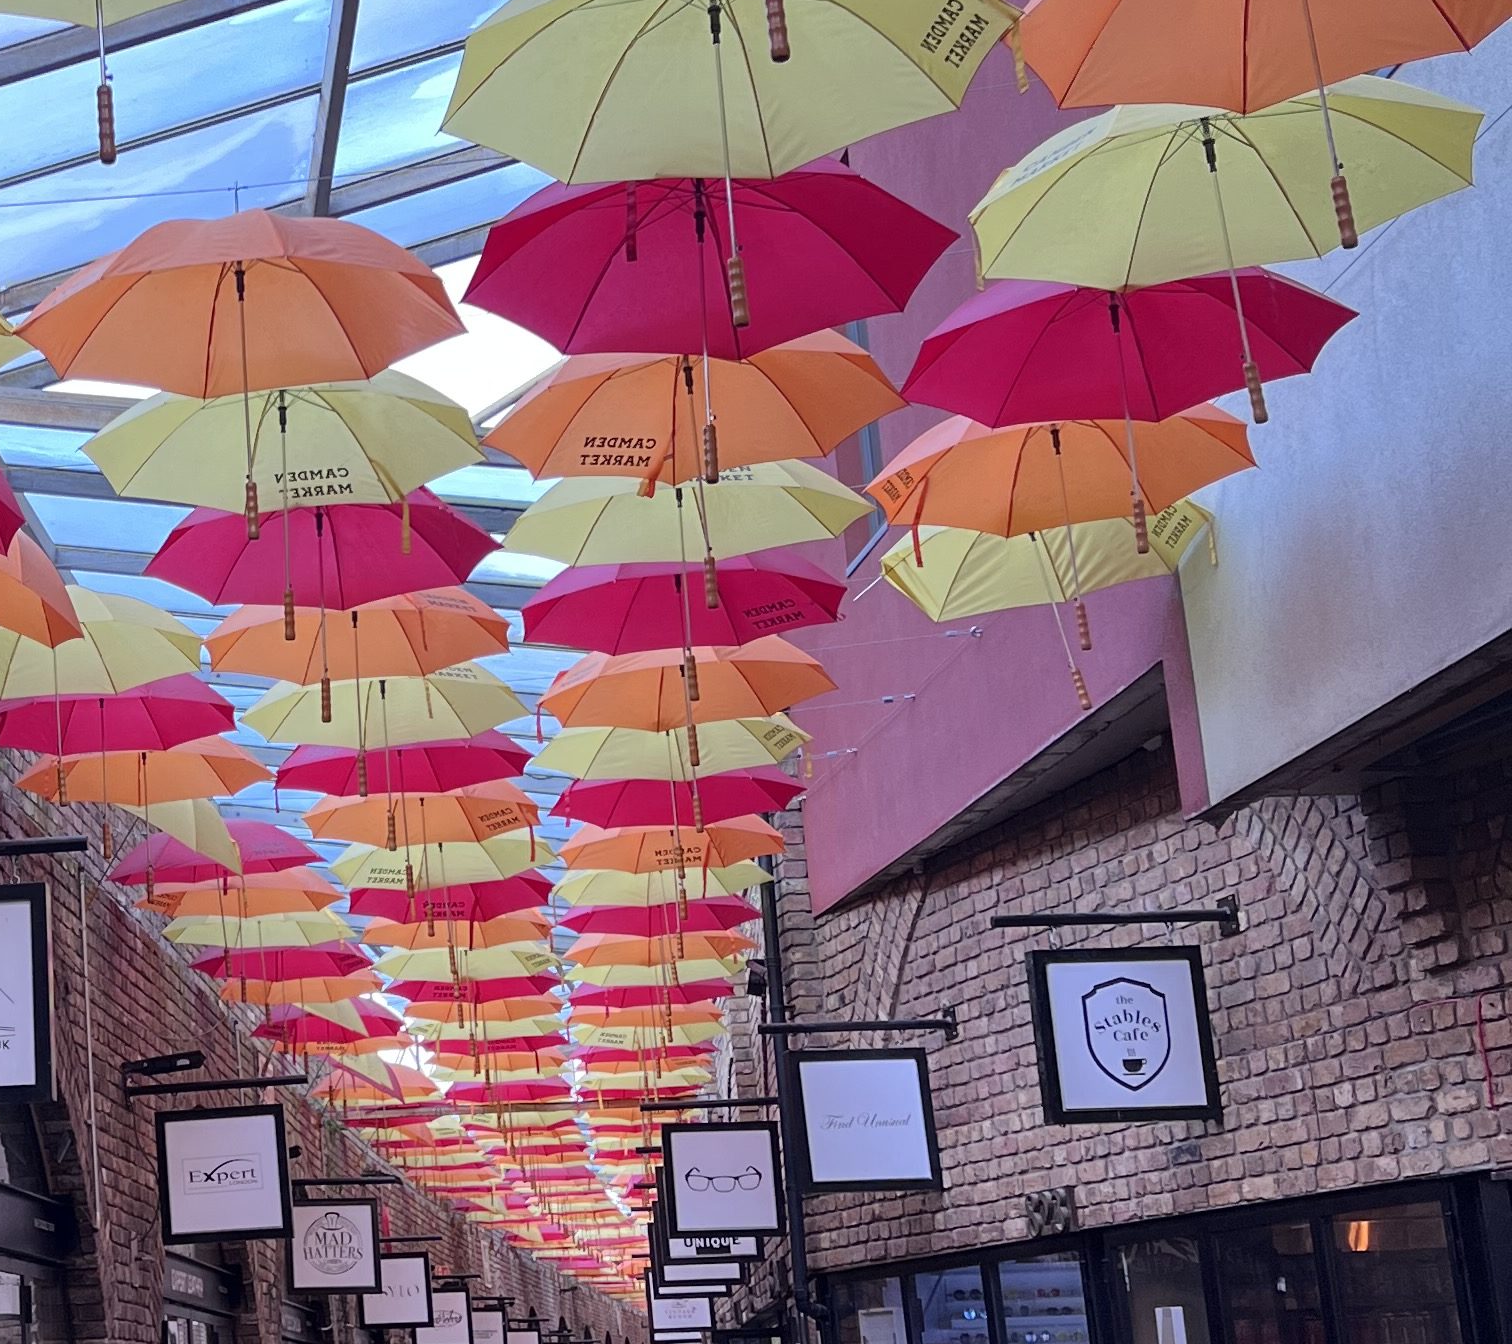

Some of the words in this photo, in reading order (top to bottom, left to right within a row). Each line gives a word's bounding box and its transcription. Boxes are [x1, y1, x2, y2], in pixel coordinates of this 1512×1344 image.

[1116, 995, 1134, 1005] the
[189, 1159, 257, 1184] Expert
[315, 1231, 352, 1246] MAD
[303, 1246, 364, 1261] HATTERS
